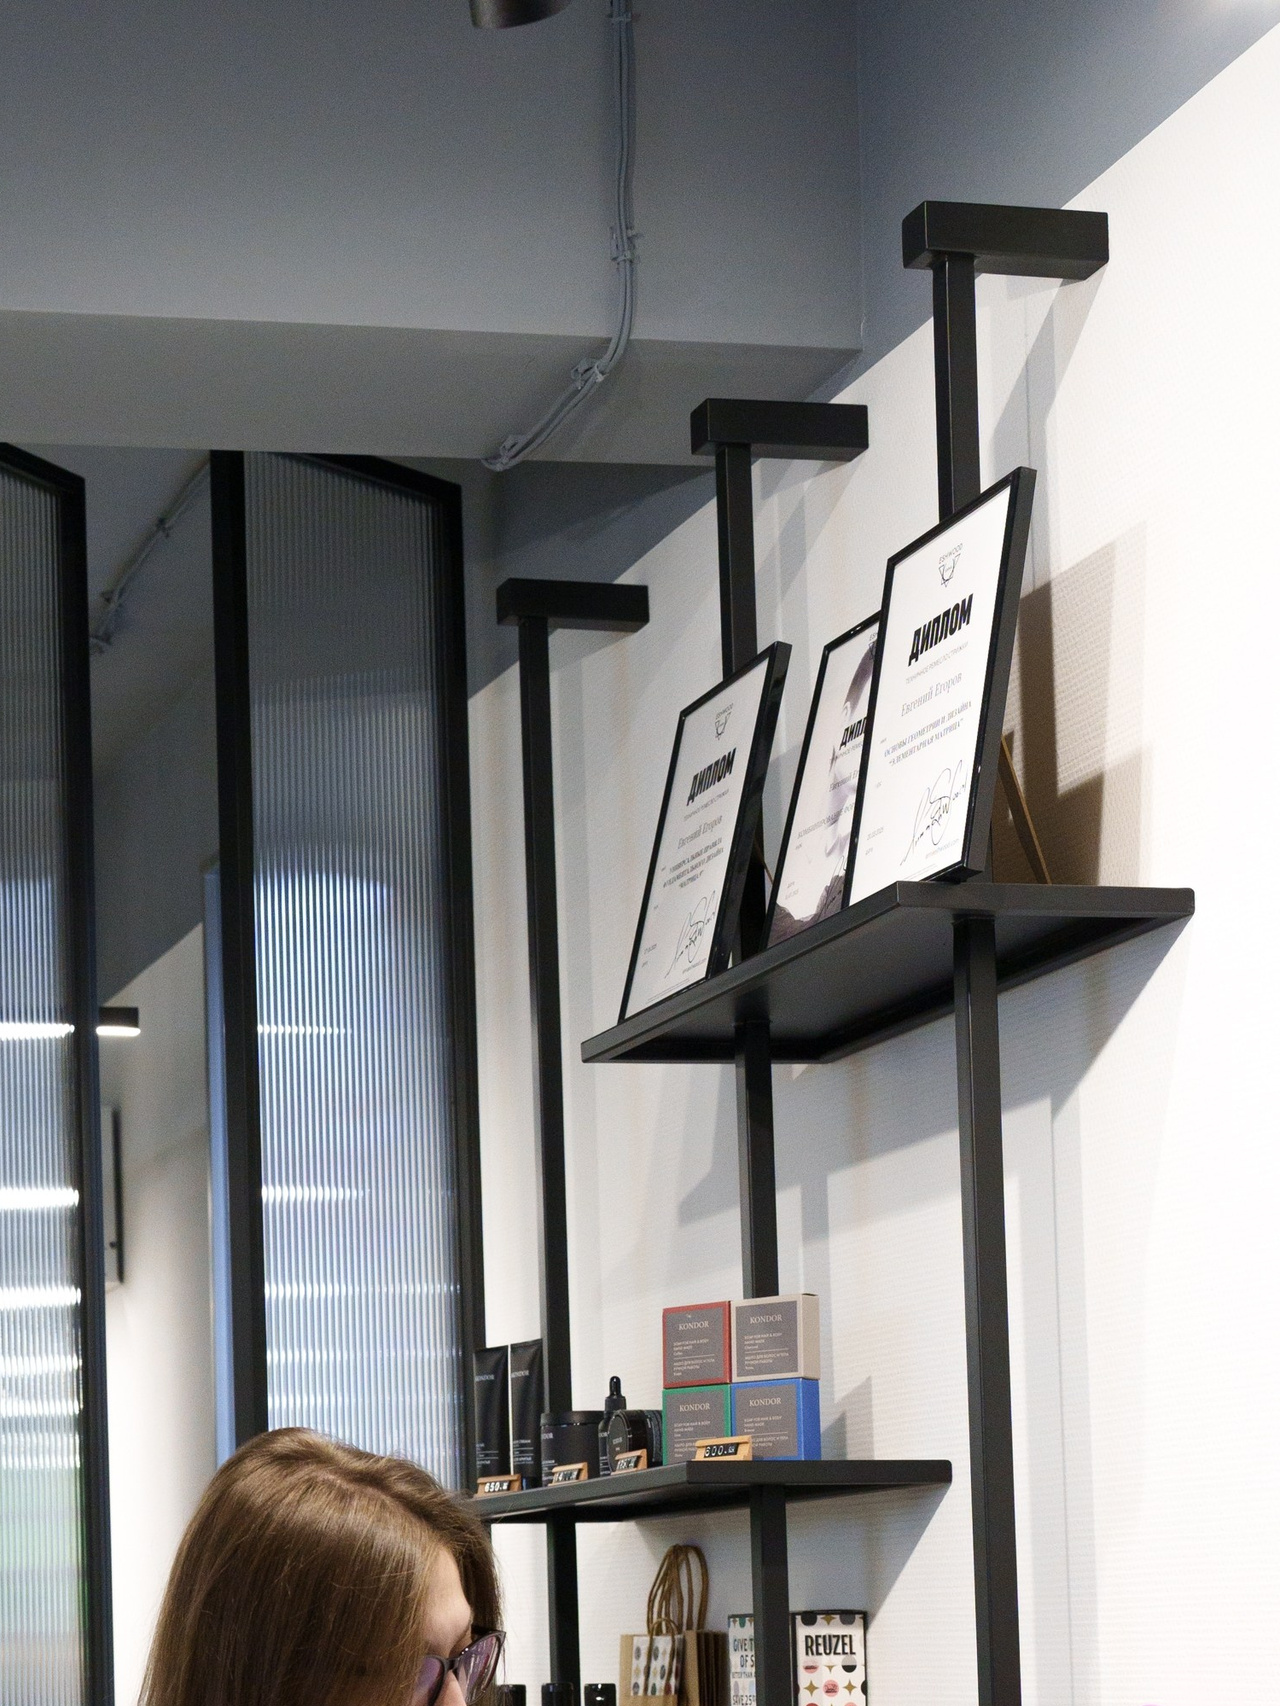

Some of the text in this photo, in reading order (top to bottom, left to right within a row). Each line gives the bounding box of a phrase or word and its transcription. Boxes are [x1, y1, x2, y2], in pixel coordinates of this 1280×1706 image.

[908, 593, 974, 667] ДИПЛОМ
[900, 671, 962, 717] Евгений Егоров
[839, 716, 868, 751] ДИПЛ
[686, 747, 737, 807] ДИПЛОМ
[678, 1321, 710, 1331] KONDOR
[749, 1314, 783, 1324] KONDOR
[679, 1403, 710, 1412] KONDOR
[749, 1397, 782, 1407] KONDOR
[733, 1638, 747, 1652] GIVE
[804, 1634, 857, 1656] REUZEL
[740, 1655, 749, 1668] OF
